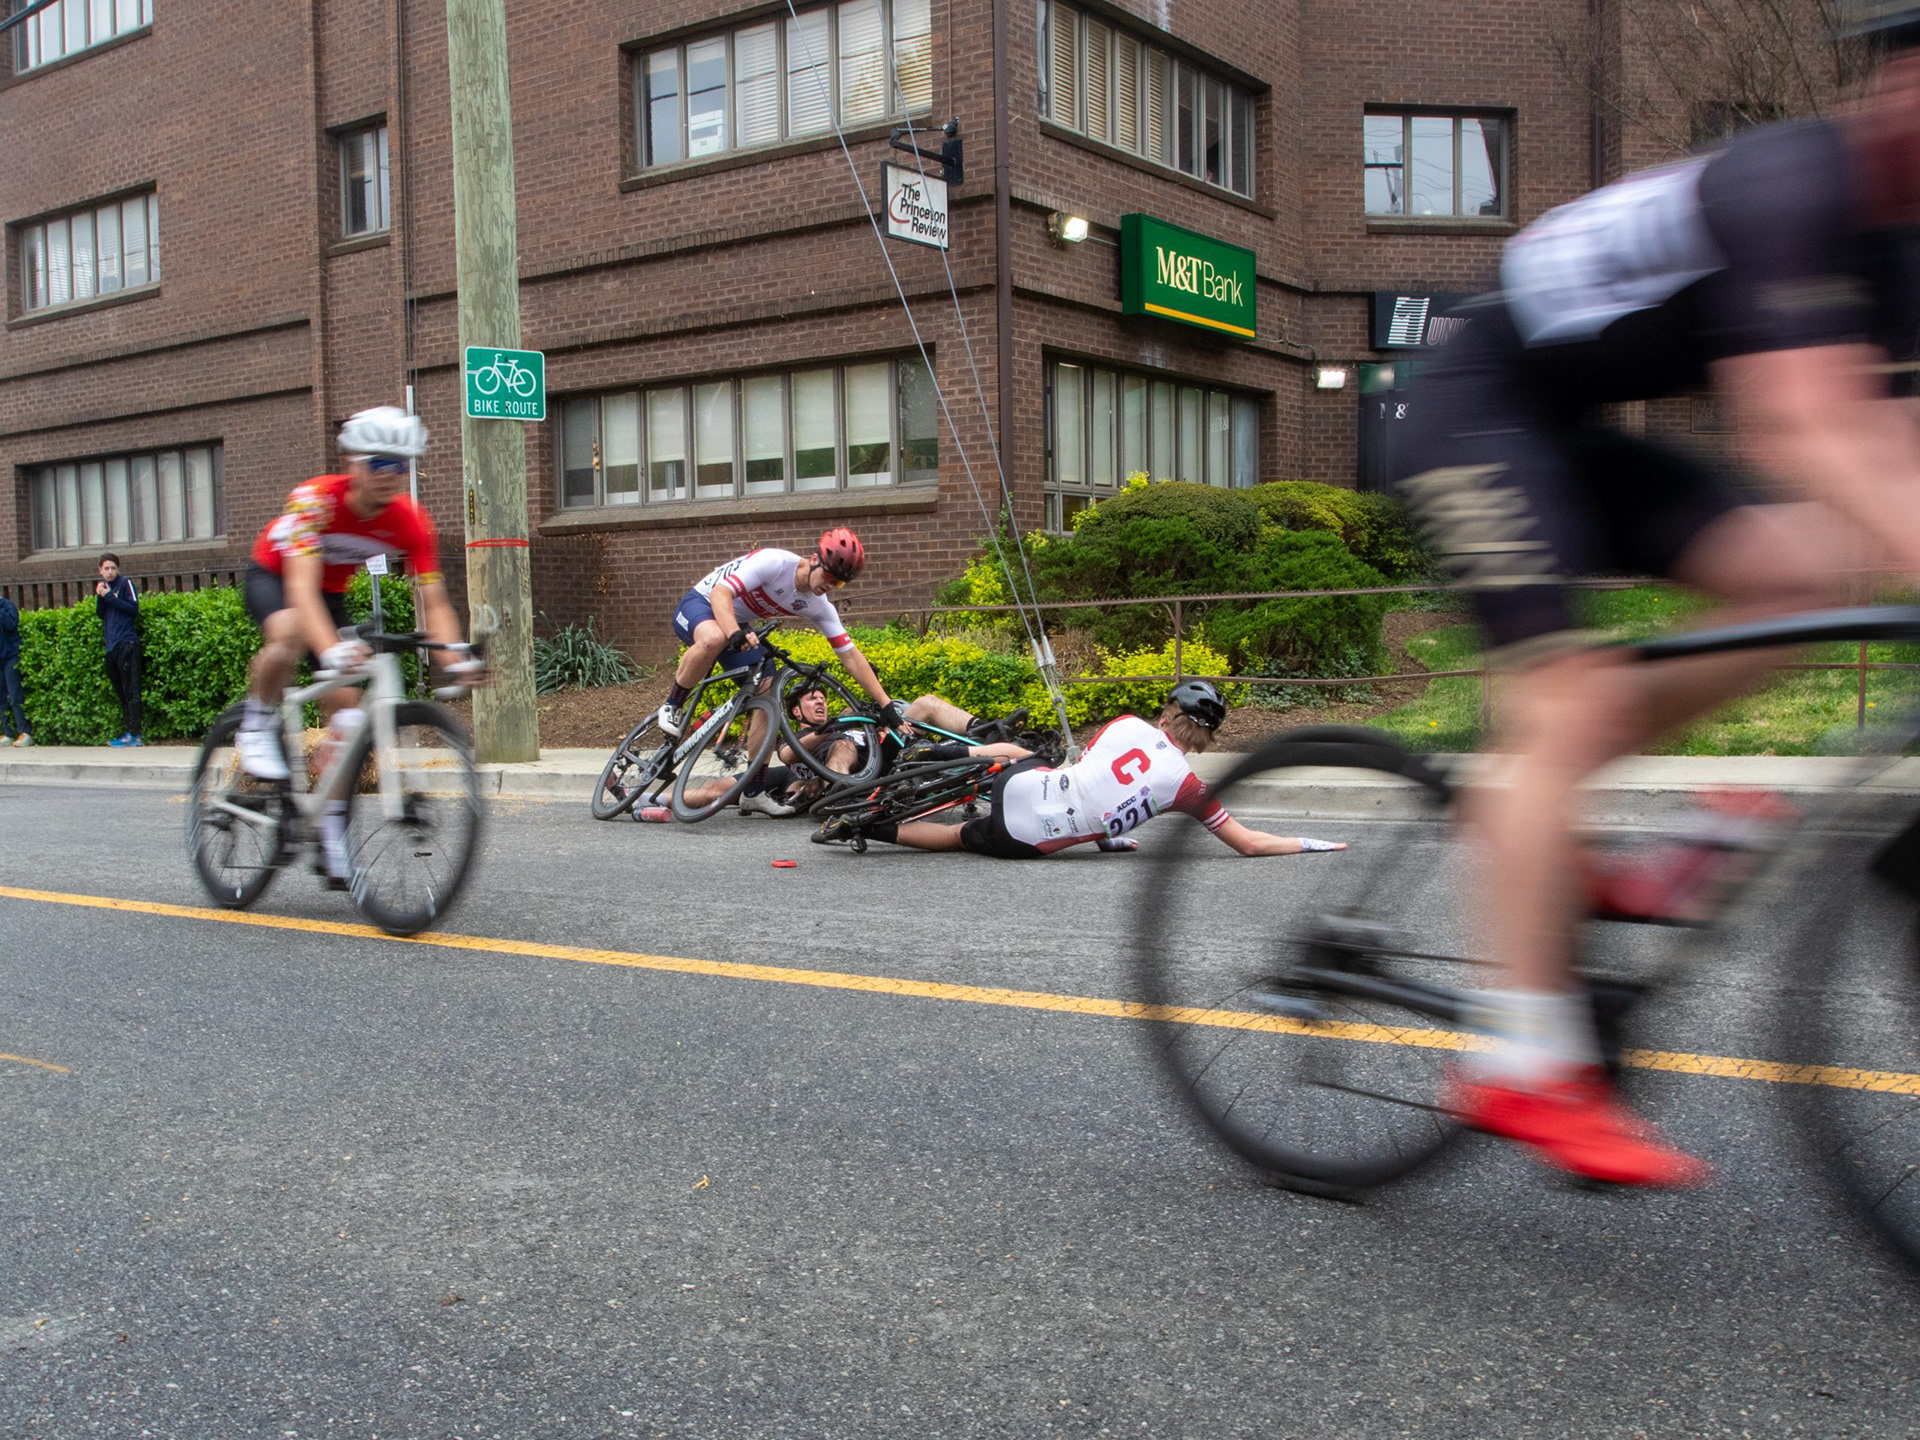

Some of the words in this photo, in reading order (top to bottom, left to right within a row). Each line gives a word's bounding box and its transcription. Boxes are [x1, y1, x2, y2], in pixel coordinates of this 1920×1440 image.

[901, 183, 921, 201] The
[900, 197, 946, 225] Princeton
[911, 217, 947, 240] Review
[1156, 246, 1202, 294] M&T
[1203, 260, 1243, 307] Bank
[474, 399, 500, 413] BIKE
[505, 400, 539, 416] ROUTE
[1111, 747, 1151, 786] C
[1116, 795, 1137, 812] ACCC
[1110, 798, 1154, 838] 221
